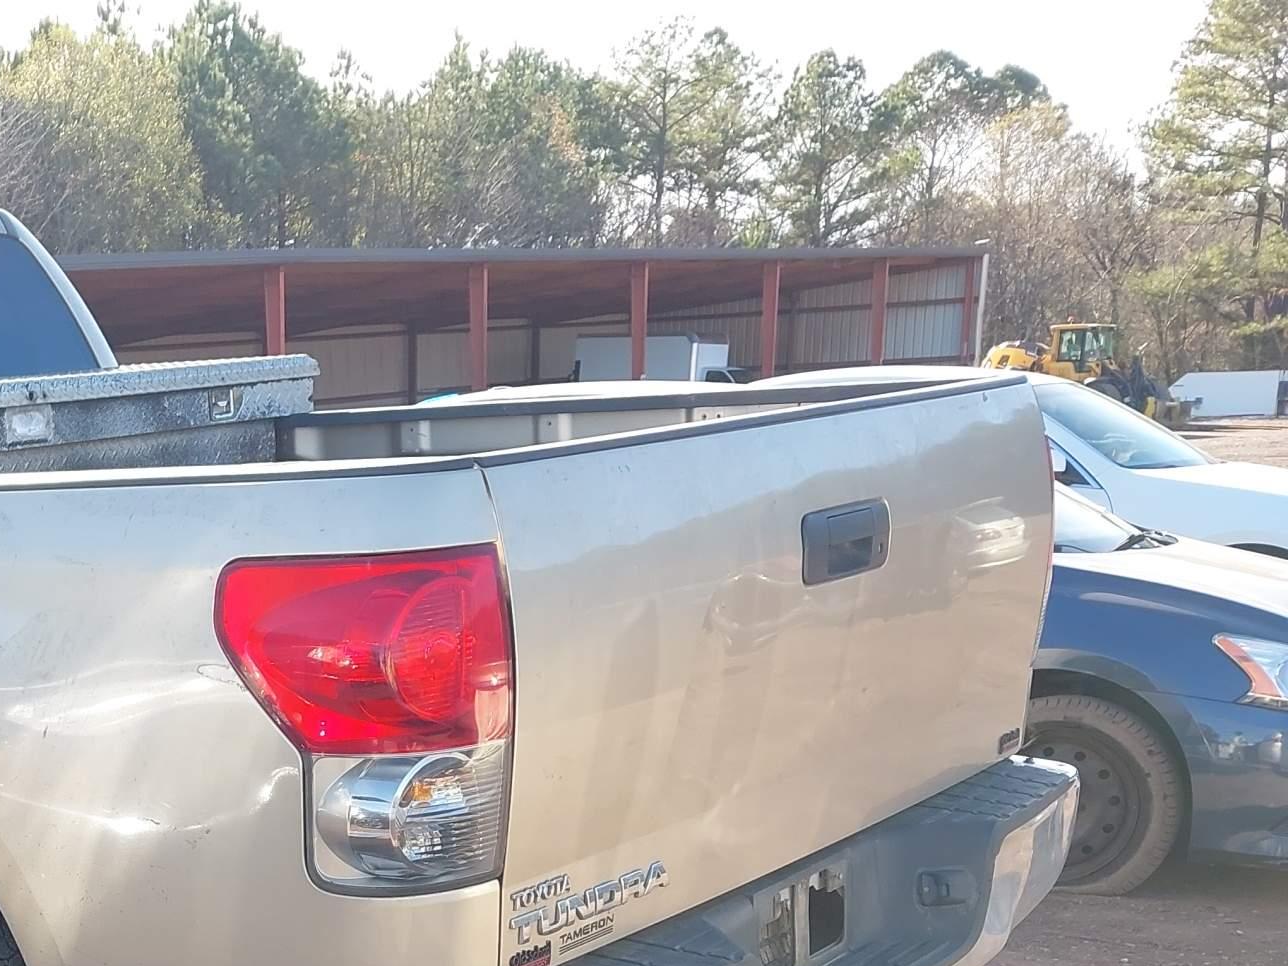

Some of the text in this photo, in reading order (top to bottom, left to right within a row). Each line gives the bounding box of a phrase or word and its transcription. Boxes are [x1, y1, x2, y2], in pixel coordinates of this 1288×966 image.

[510, 874, 571, 910] TOYOTA
[510, 860, 669, 945] TUNDRA
[560, 914, 614, 945] TAMERON
